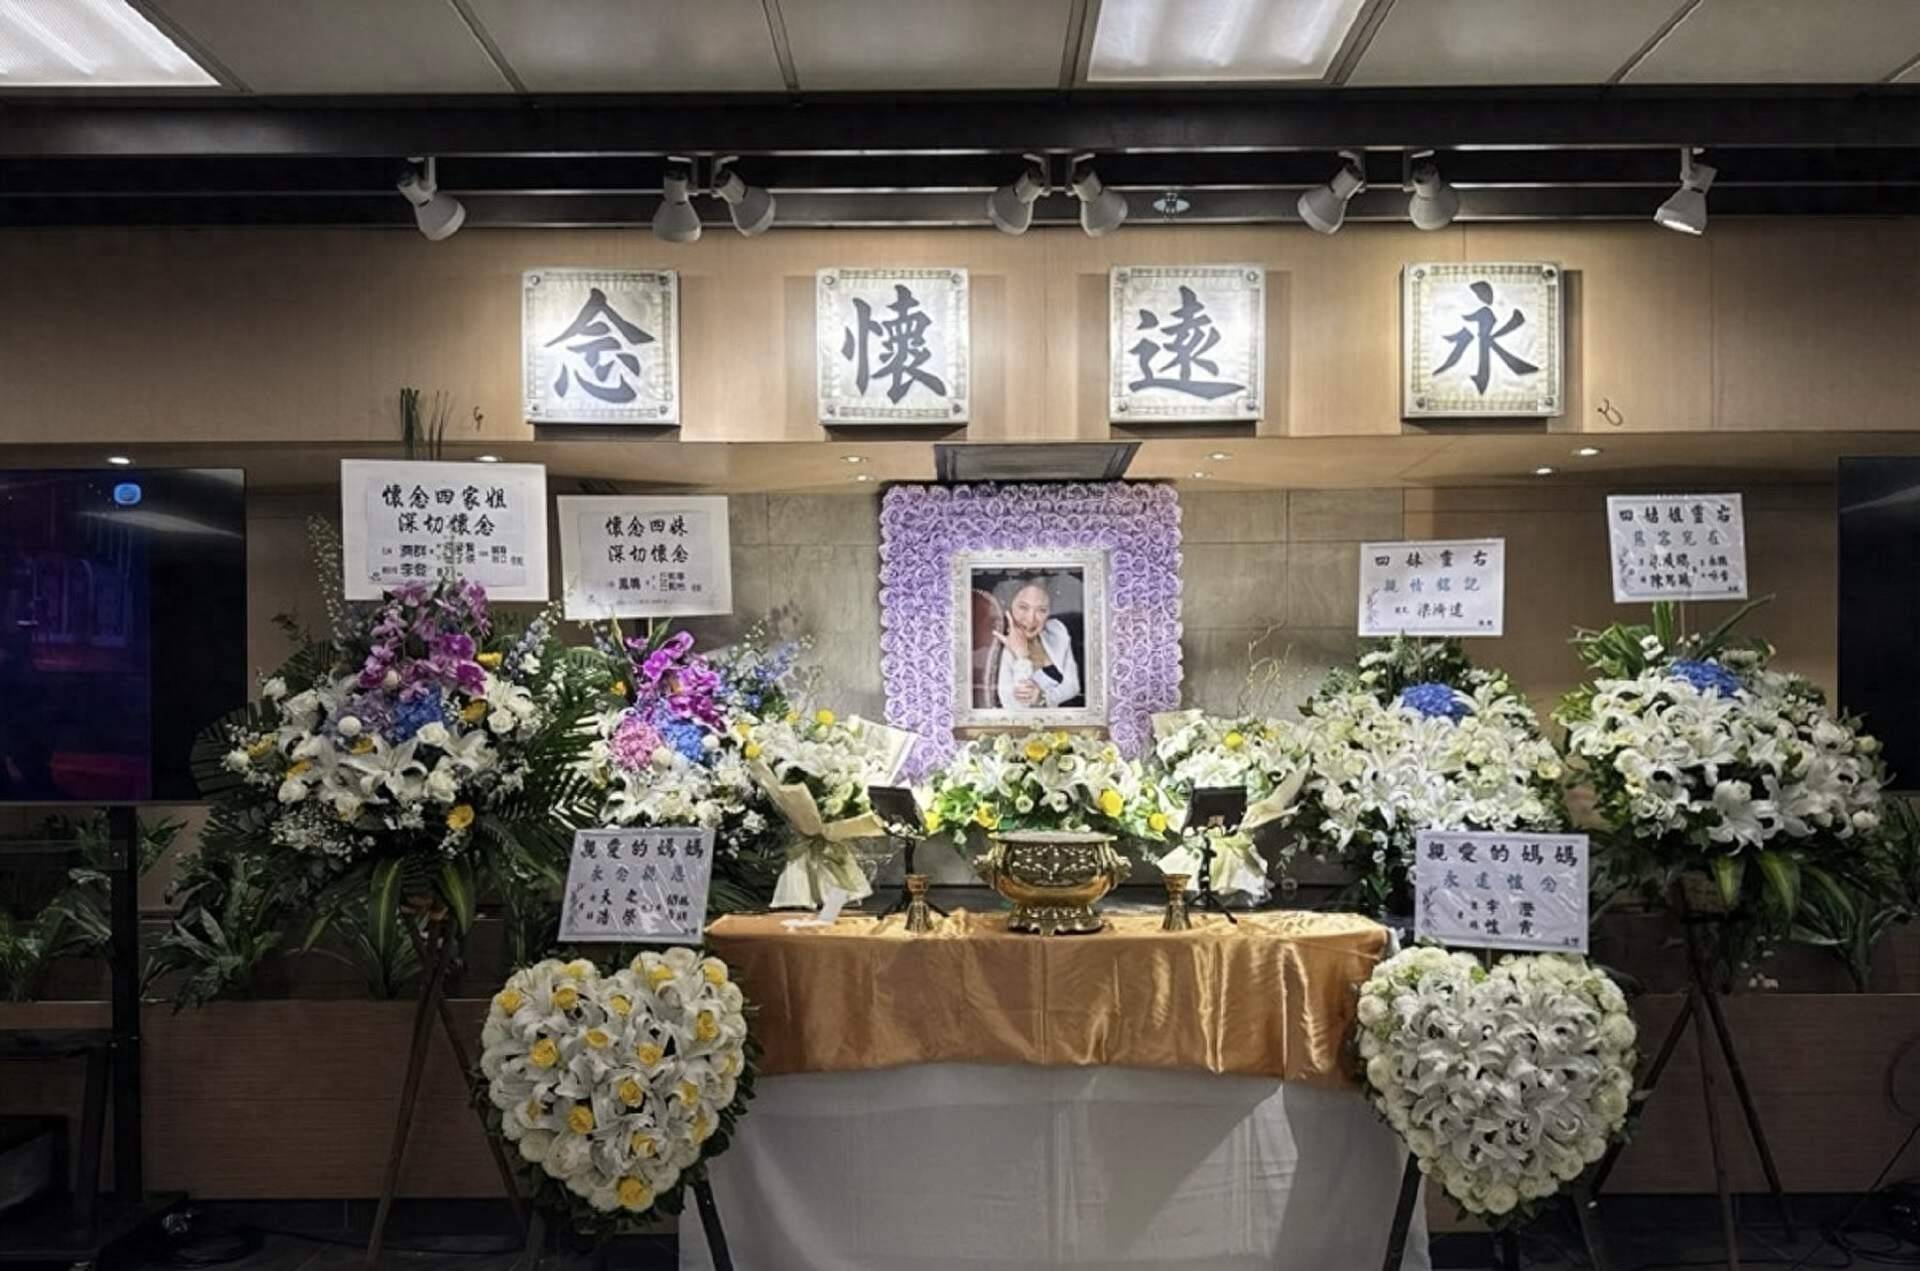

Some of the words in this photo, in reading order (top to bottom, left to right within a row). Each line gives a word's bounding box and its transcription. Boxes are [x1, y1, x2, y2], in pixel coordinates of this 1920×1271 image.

[545, 287, 655, 403] 念
[841, 284, 947, 404] 懷
[1129, 285, 1246, 400] 遠
[1432, 280, 1539, 396] 永
[382, 484, 508, 511] 懷念四家姐
[398, 512, 496, 537] 深切懷念
[608, 544, 689, 563] 深切懷念
[580, 837, 704, 859] 親愛的媽媽
[1427, 842, 1579, 867] 親愛的媽媽
